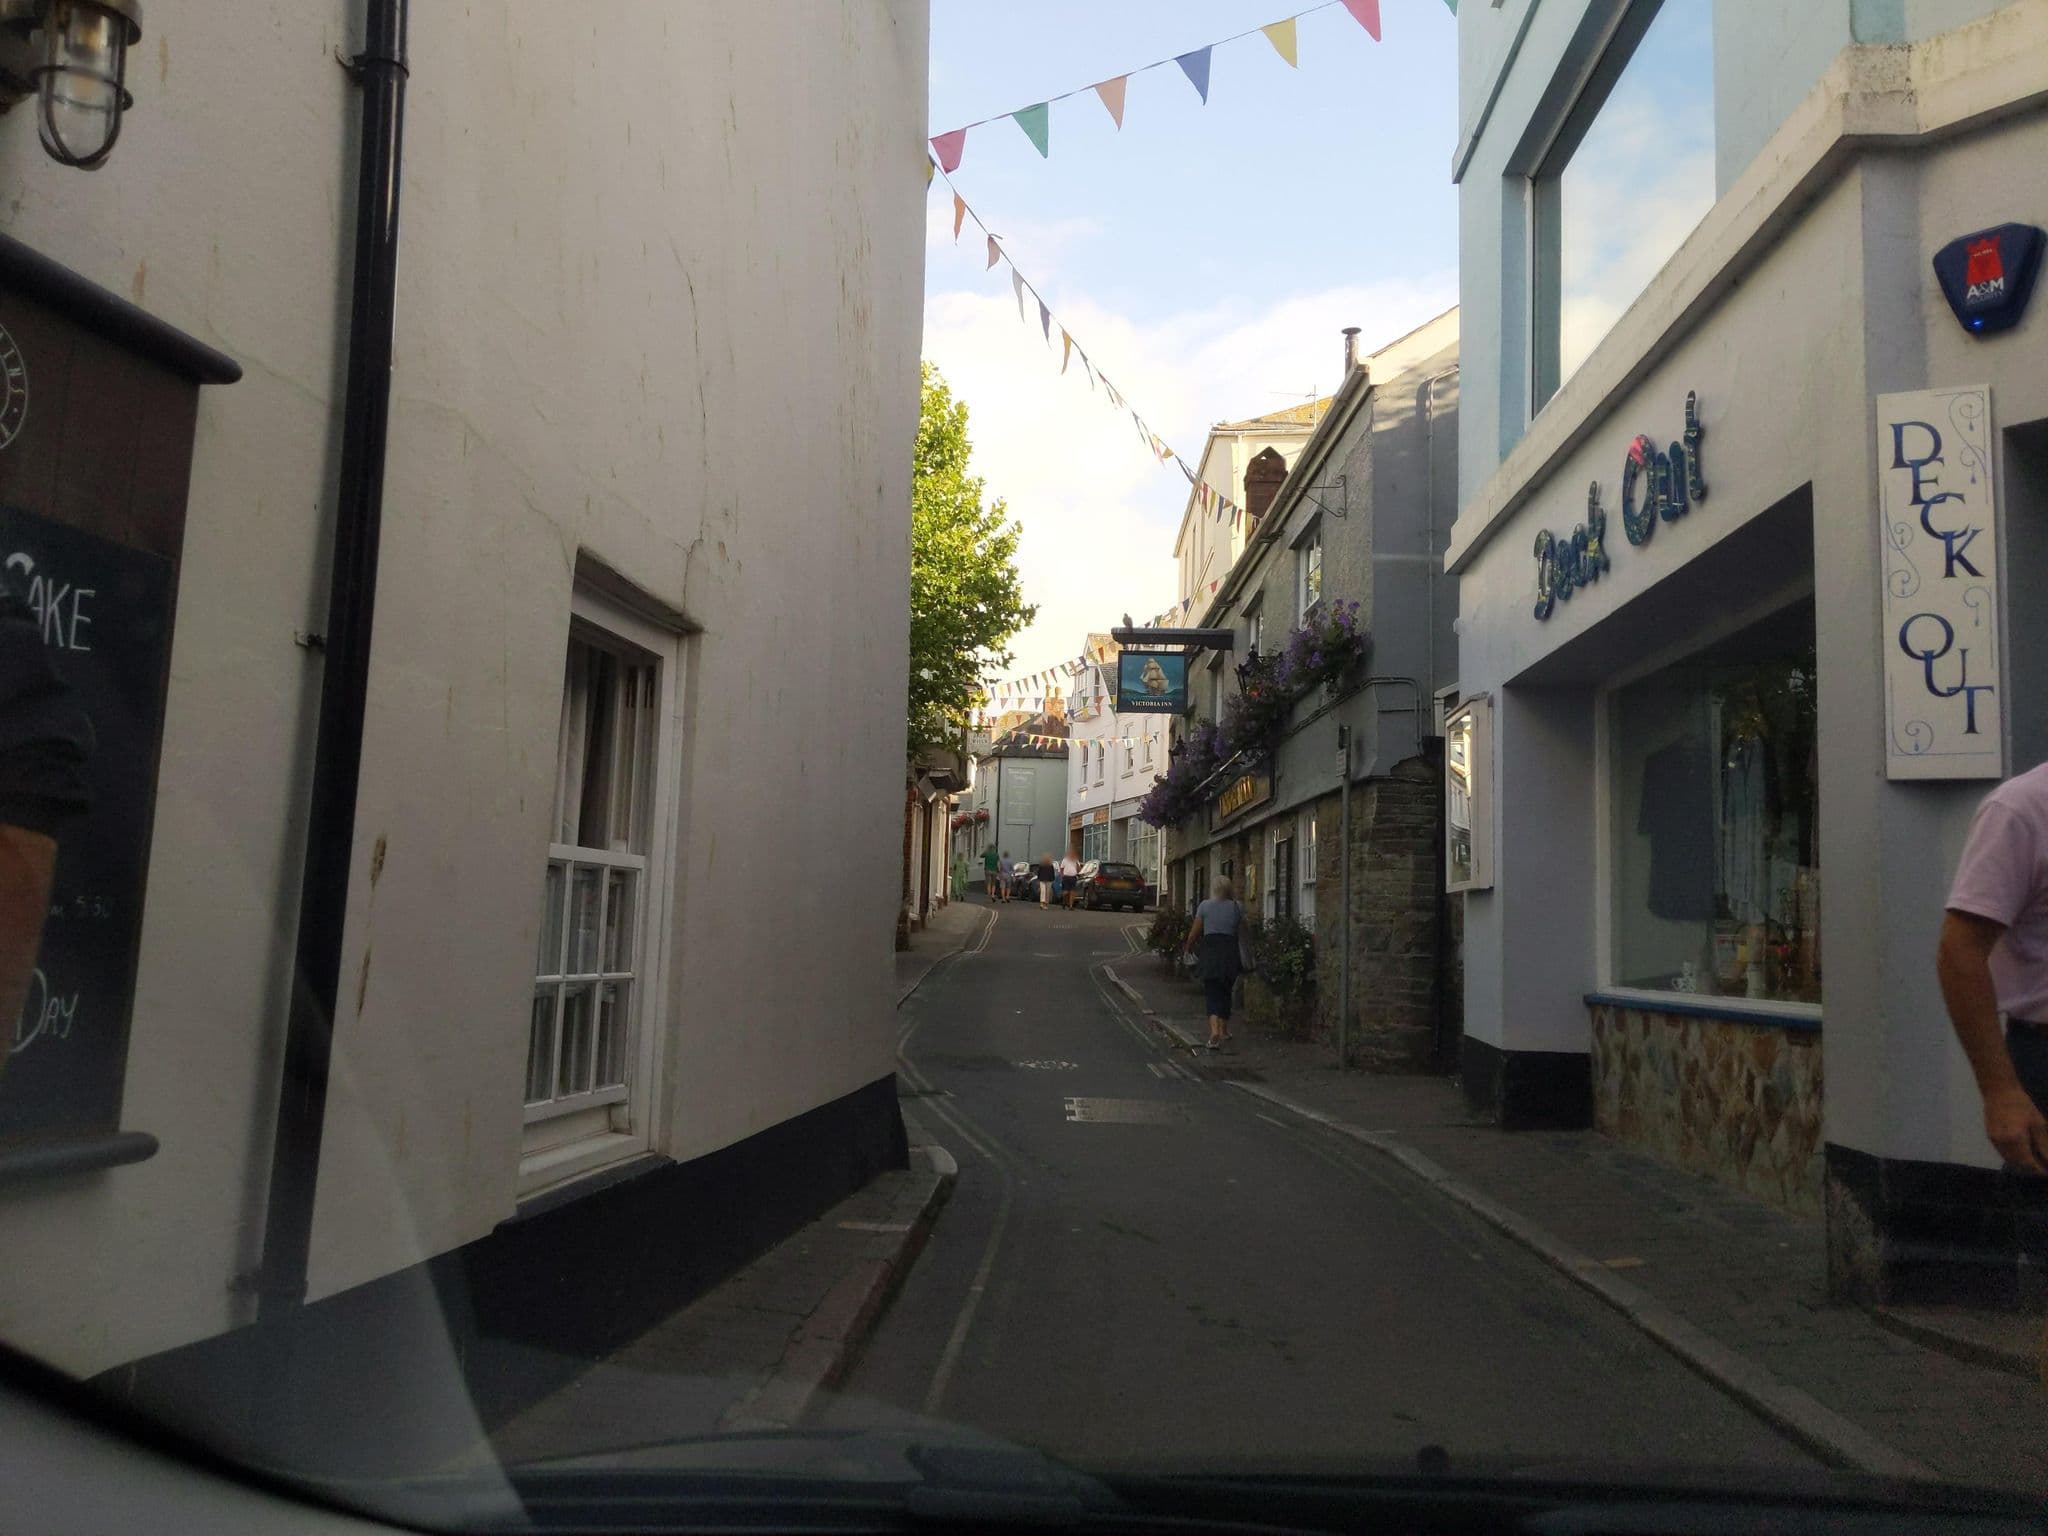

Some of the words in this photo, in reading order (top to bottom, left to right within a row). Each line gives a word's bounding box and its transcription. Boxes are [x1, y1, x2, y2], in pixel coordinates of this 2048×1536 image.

[1966, 276, 2004, 299] A&M
[1622, 390, 1706, 546] Out
[1889, 420, 1986, 579] DECK
[1898, 612, 1995, 735] OUT
